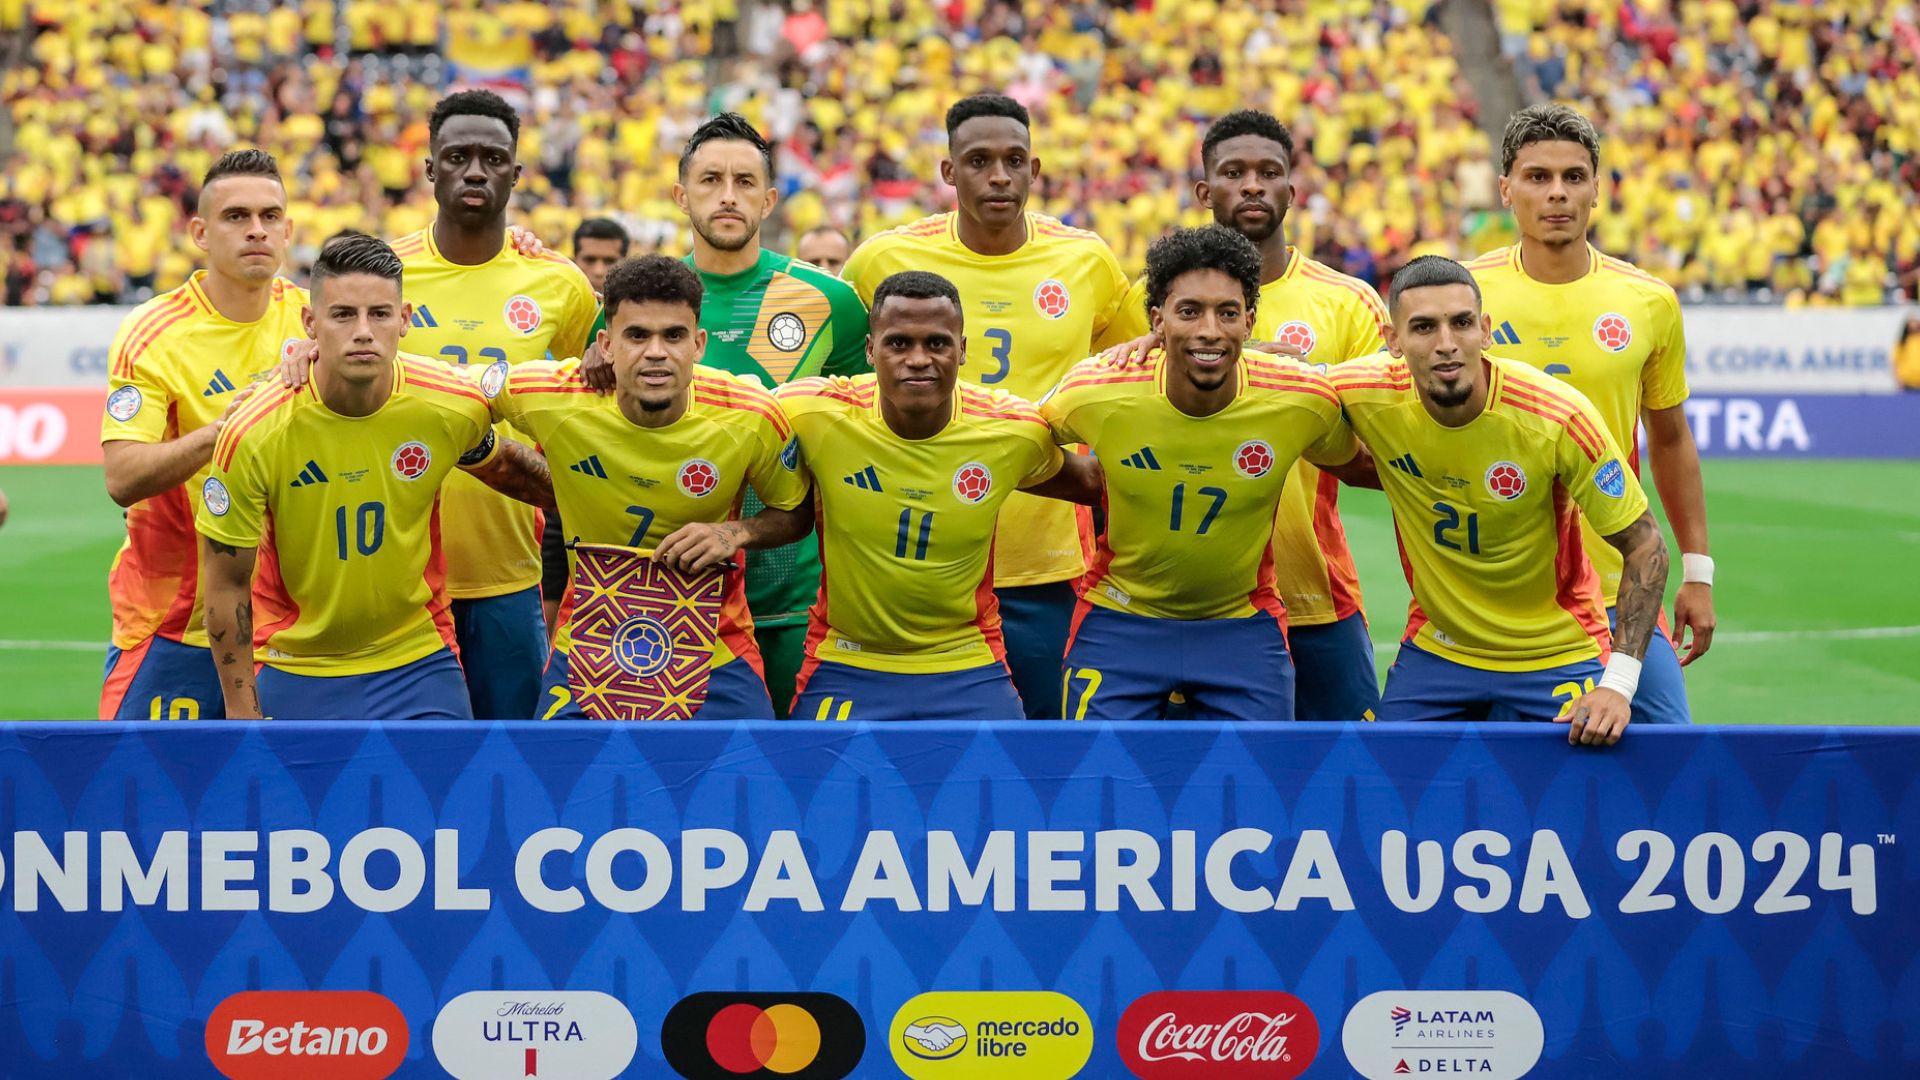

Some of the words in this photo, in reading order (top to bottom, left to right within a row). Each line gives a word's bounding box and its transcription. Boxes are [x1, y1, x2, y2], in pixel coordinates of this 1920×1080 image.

[980, 328, 1012, 384] 3
[625, 505, 655, 547] 7
[1169, 483, 1228, 535] 17
[1432, 501, 1481, 555] 21
[336, 501, 385, 561] 10
[894, 507, 934, 560] 11
[1062, 667, 1103, 720] 17
[0, 828, 491, 913] NMEBOL
[514, 828, 825, 913] COPA
[840, 828, 1356, 913] AMERICA
[1380, 828, 1592, 919] USA
[496, 1001, 564, 1017] Michelob
[976, 1017, 1079, 1037] mercado
[1417, 1010, 1495, 1024] LATAM
[227, 1020, 388, 1056] Betano
[483, 1021, 584, 1042] ULTRA
[976, 1037, 1027, 1057] libre
[1417, 1029, 1495, 1038] AIRLINES
[1418, 1059, 1493, 1073] DELTA
